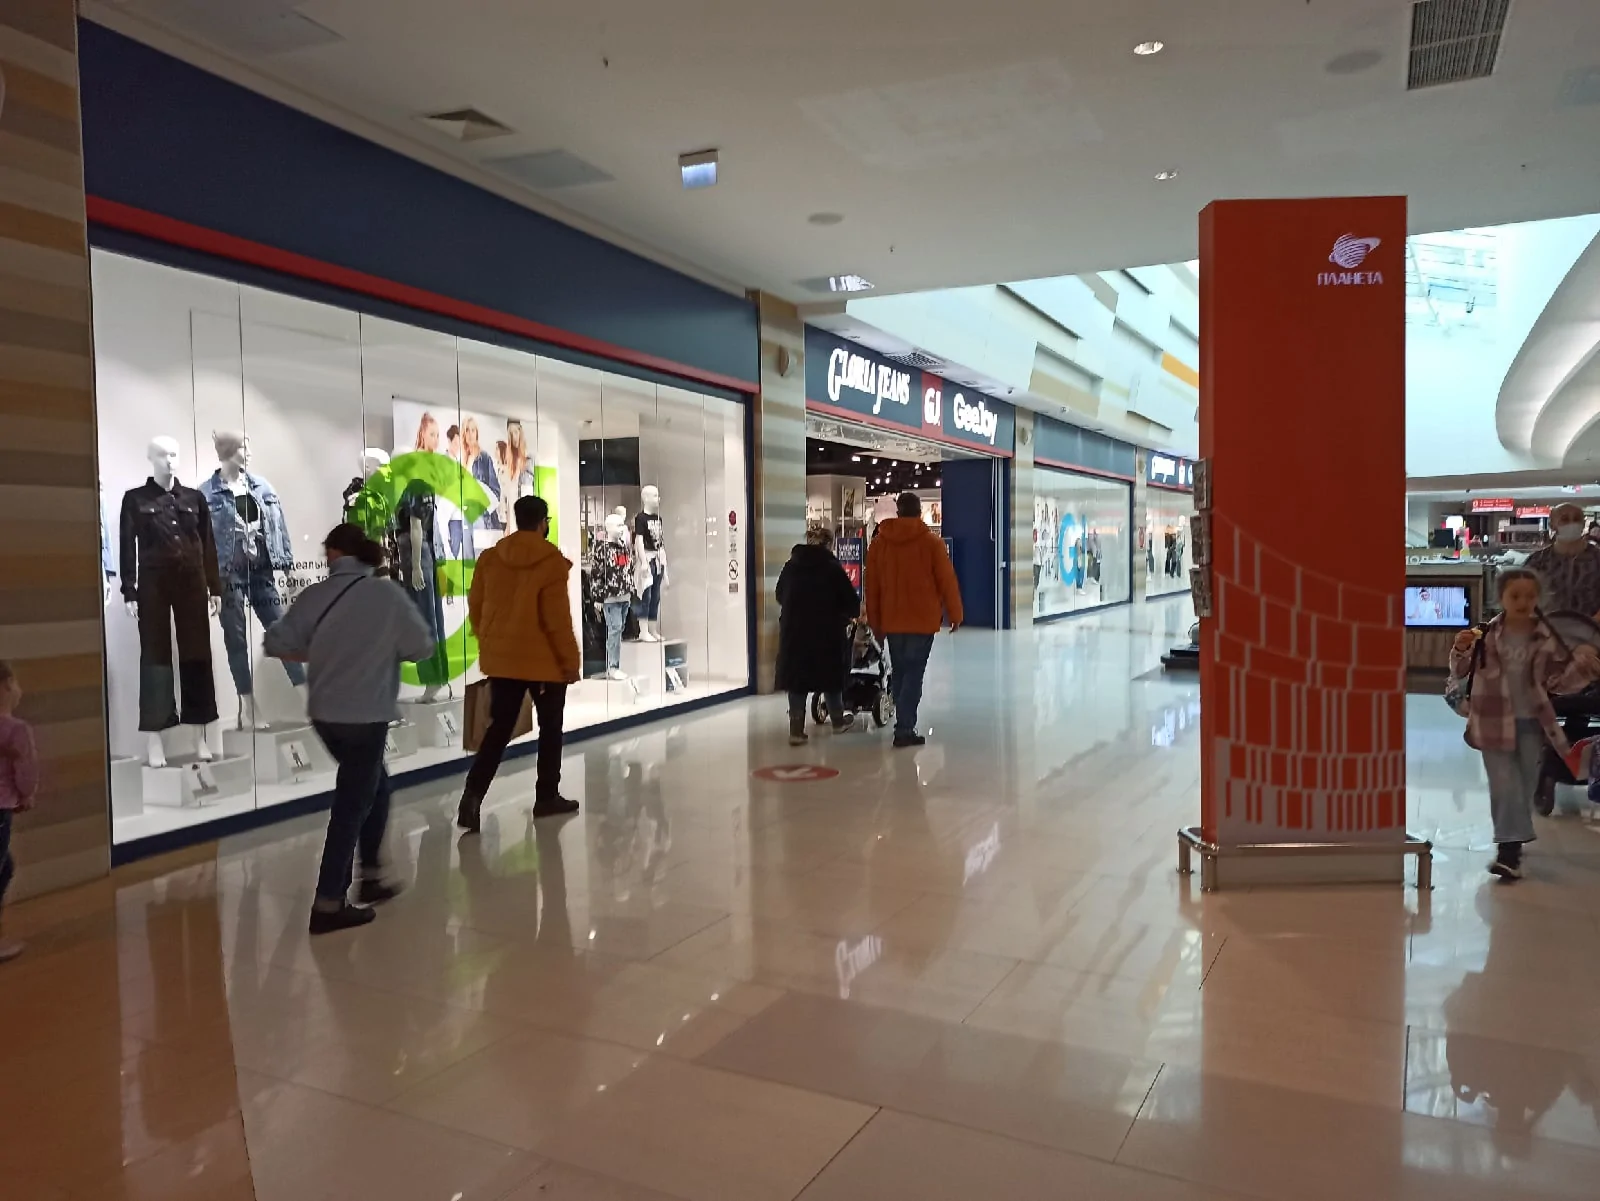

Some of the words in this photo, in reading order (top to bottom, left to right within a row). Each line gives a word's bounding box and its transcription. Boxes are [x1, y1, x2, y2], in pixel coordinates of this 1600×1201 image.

[1317, 271, 1384, 286] ПЛАНЕТА
[827, 347, 876, 402] GLORIA
[872, 363, 911, 415] JEANS
